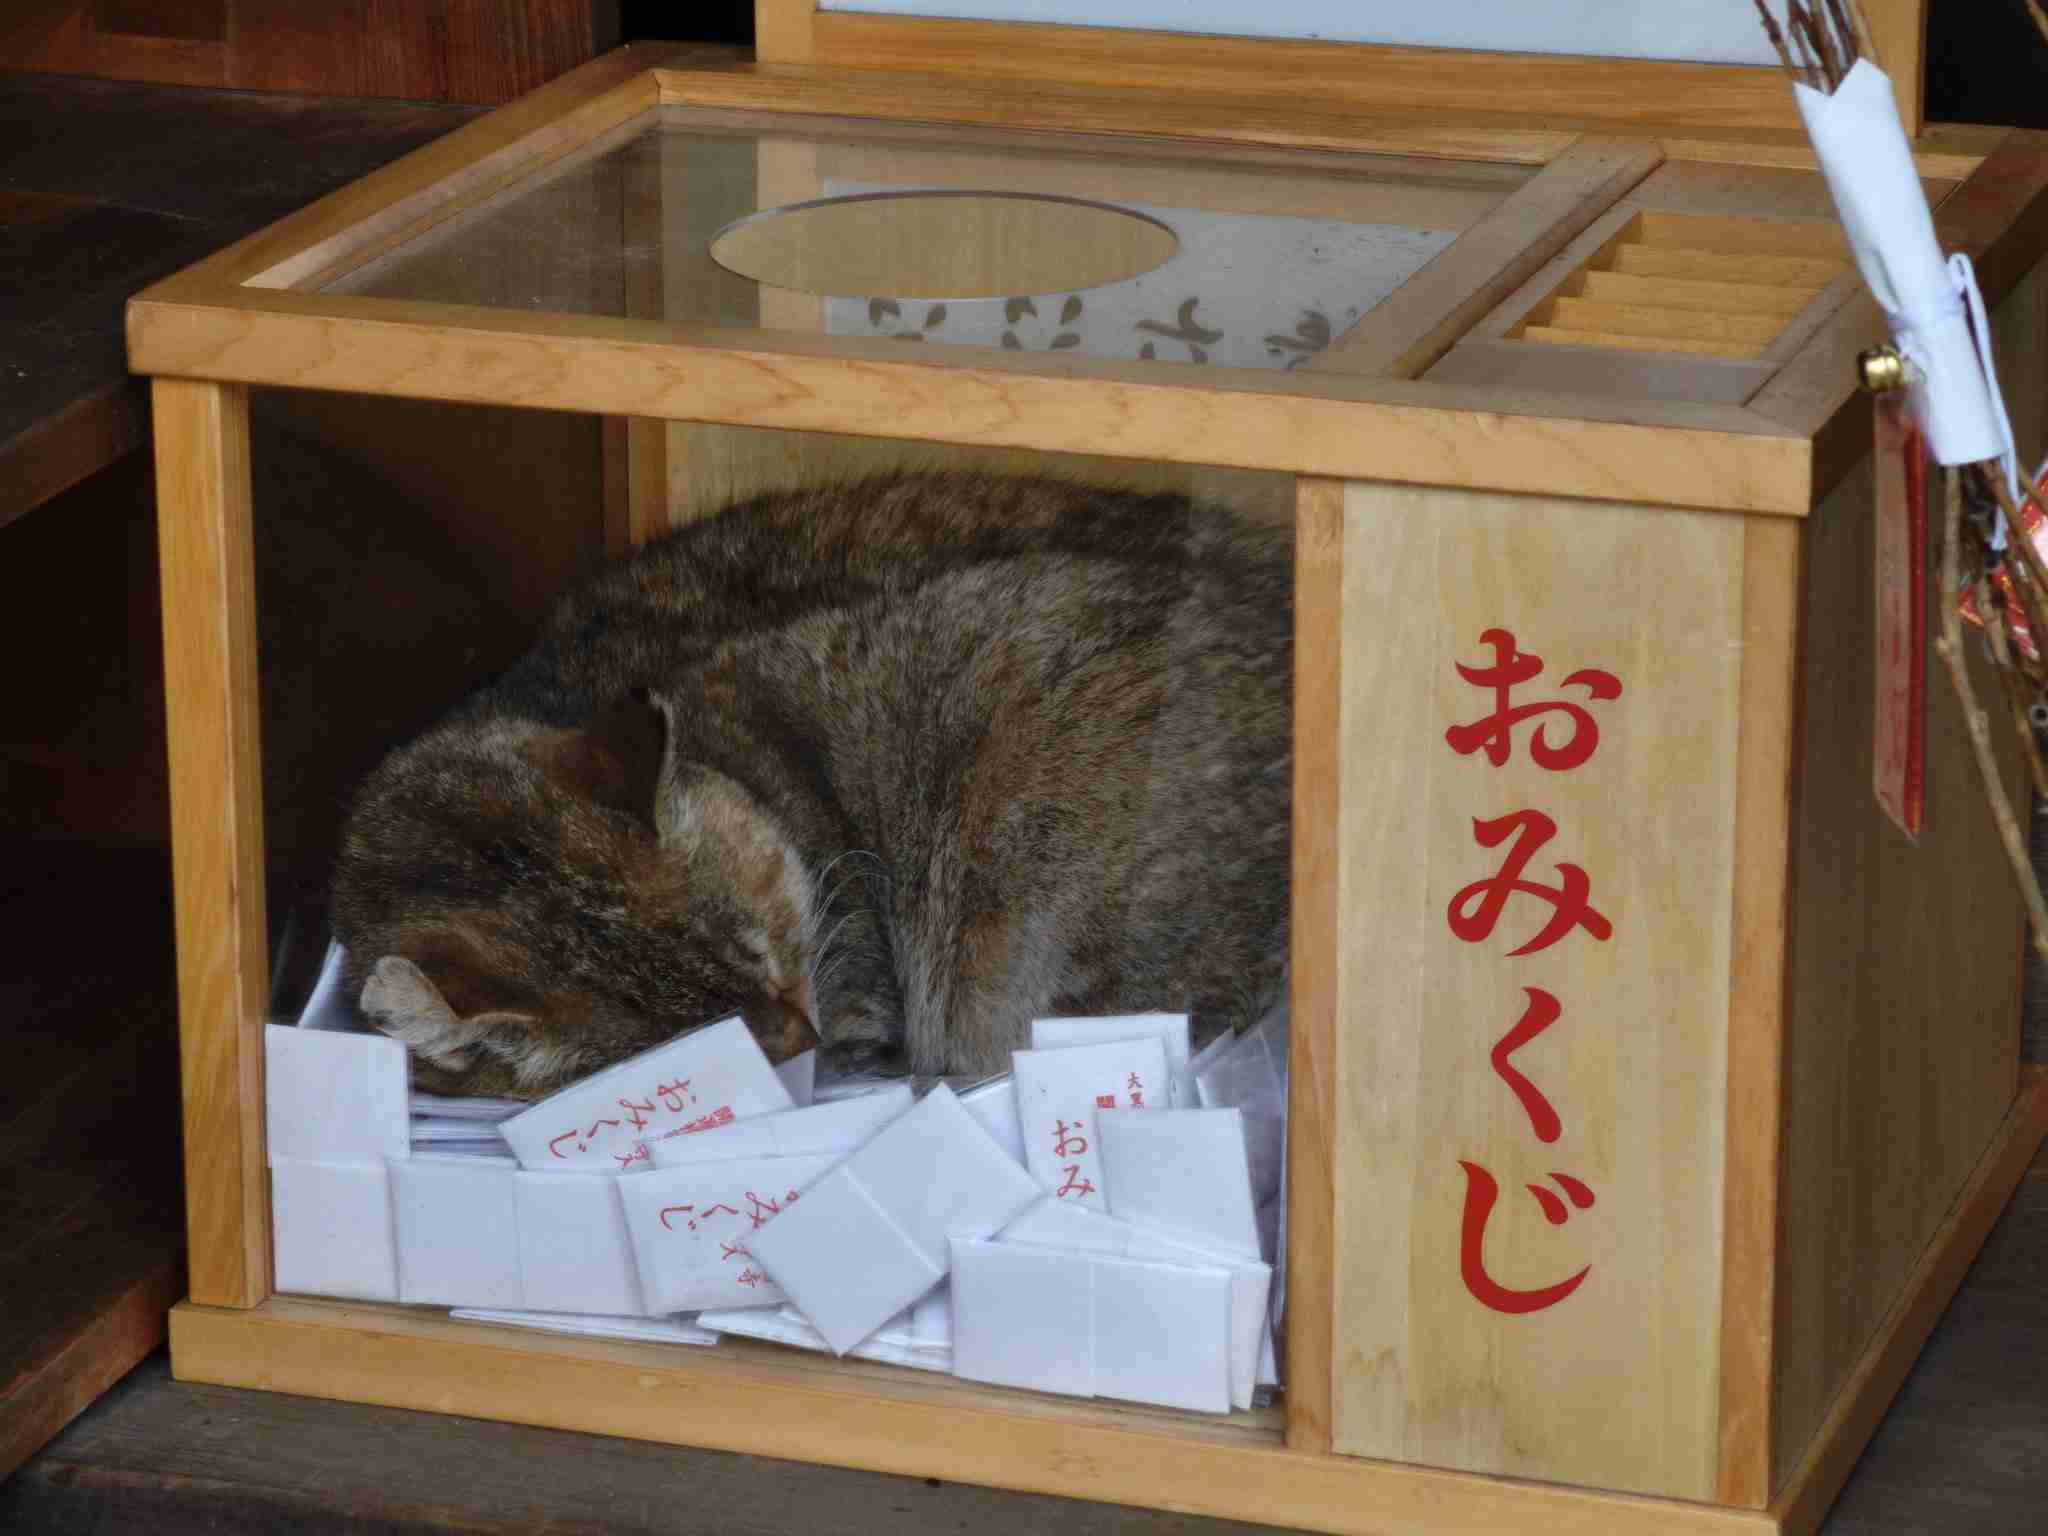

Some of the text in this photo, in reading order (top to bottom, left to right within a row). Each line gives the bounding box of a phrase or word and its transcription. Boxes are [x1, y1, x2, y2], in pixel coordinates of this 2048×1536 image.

[1445, 628, 1622, 1314] おみくじ
[549, 1078, 699, 1160] おみくじ
[660, 1190, 800, 1232] みくじ
